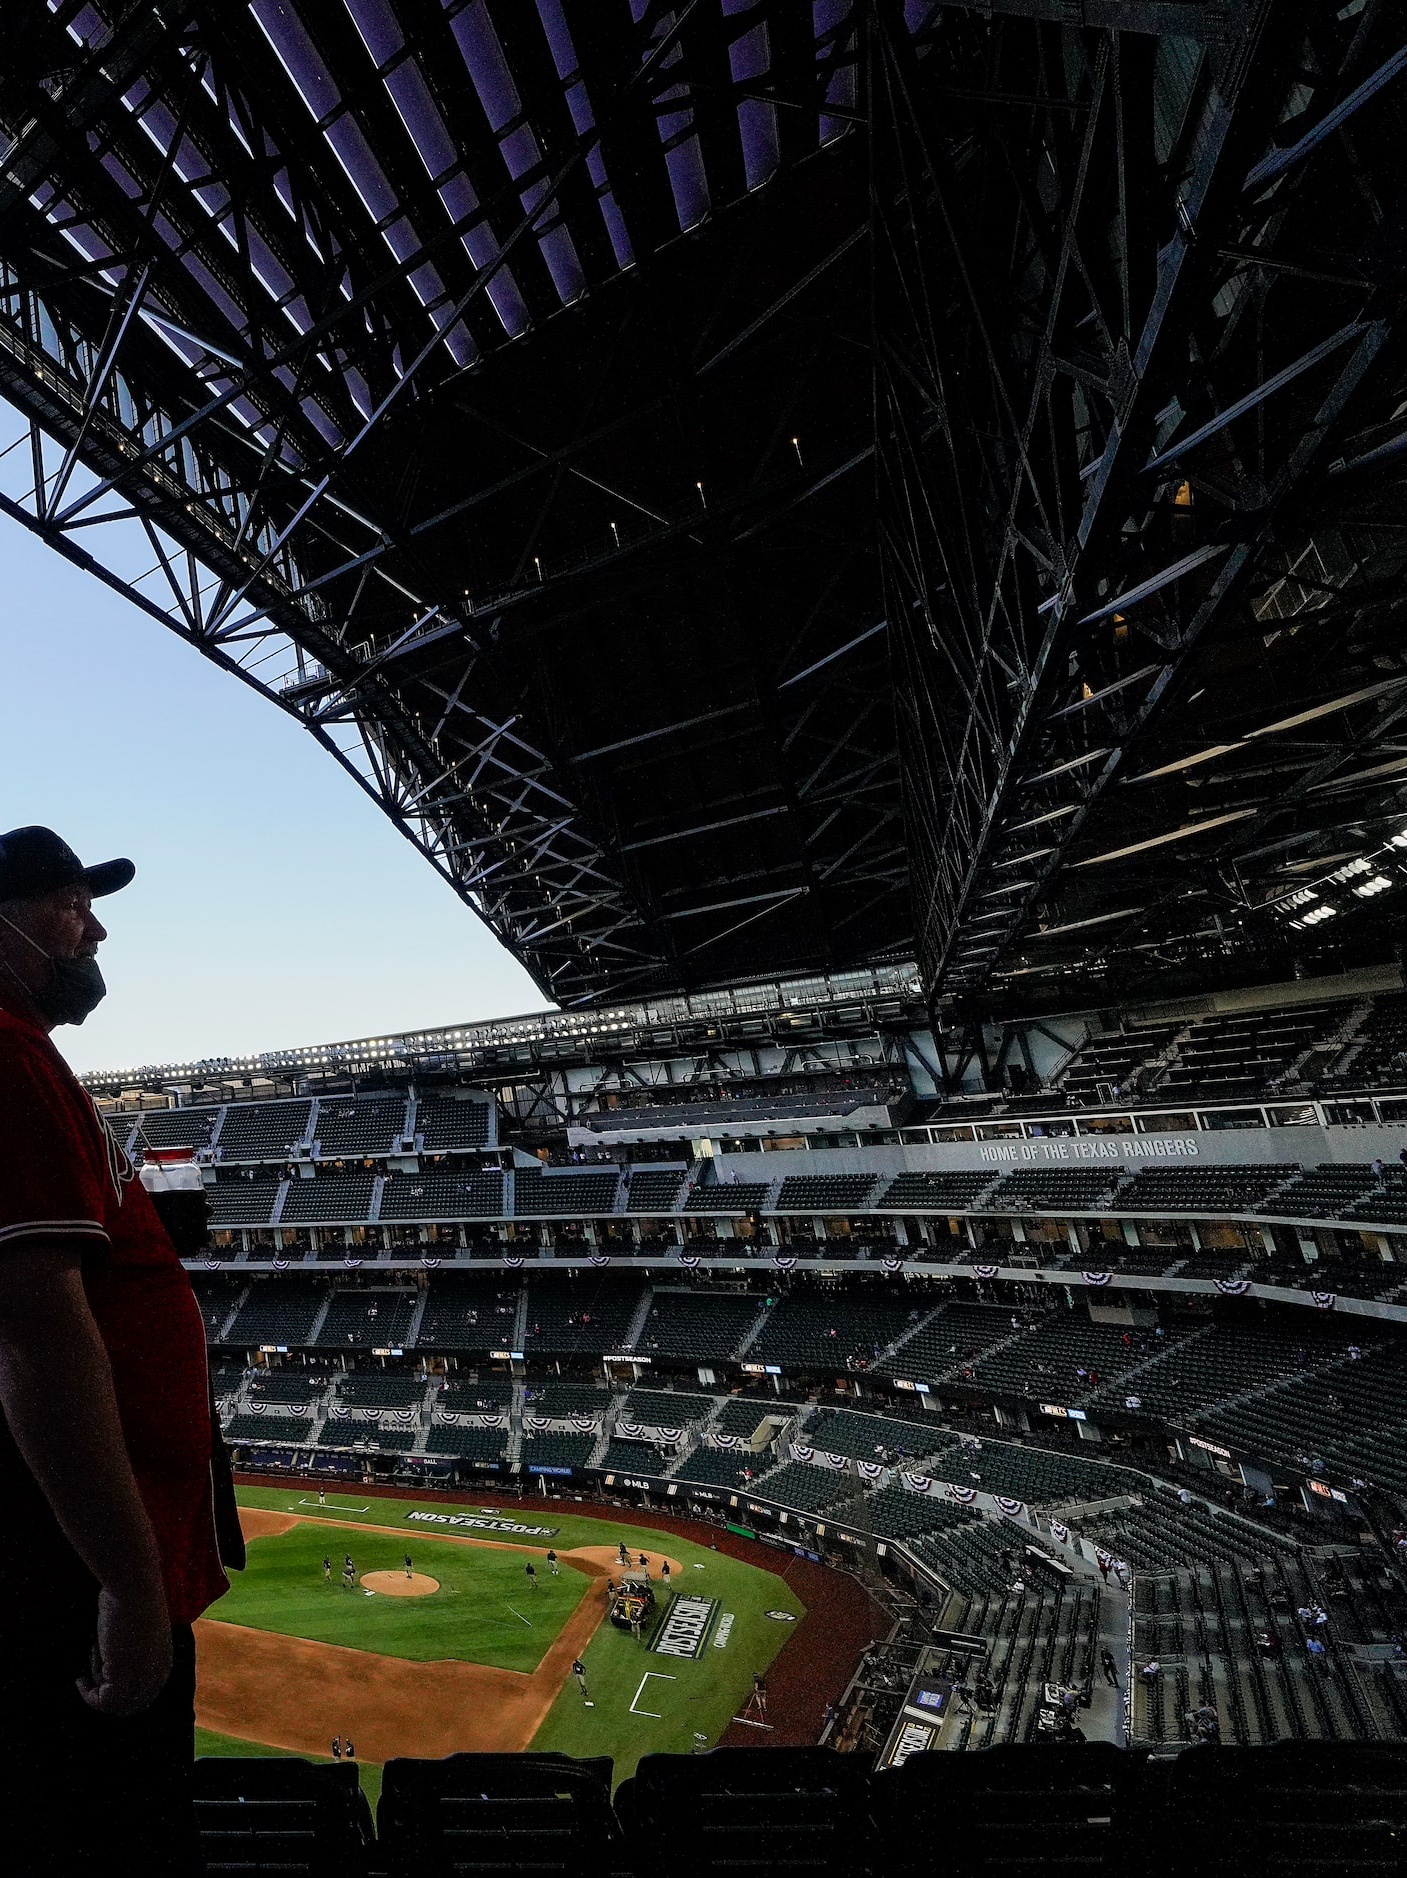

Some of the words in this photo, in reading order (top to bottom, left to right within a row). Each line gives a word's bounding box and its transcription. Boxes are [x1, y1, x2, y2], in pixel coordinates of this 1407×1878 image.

[981, 1146, 1019, 1162] HOME
[1021, 1145, 1039, 1160] OF
[1041, 1144, 1070, 1159] THE
[1070, 1141, 1119, 1159] TEXAS
[1122, 1138, 1200, 1157] RANGERS
[603, 1355, 651, 1364] #POSTSEASON
[1189, 1437, 1231, 1459] #POSTSEASON
[632, 1480, 650, 1490] MLB
[656, 1599, 713, 1658] POSTSEASON
